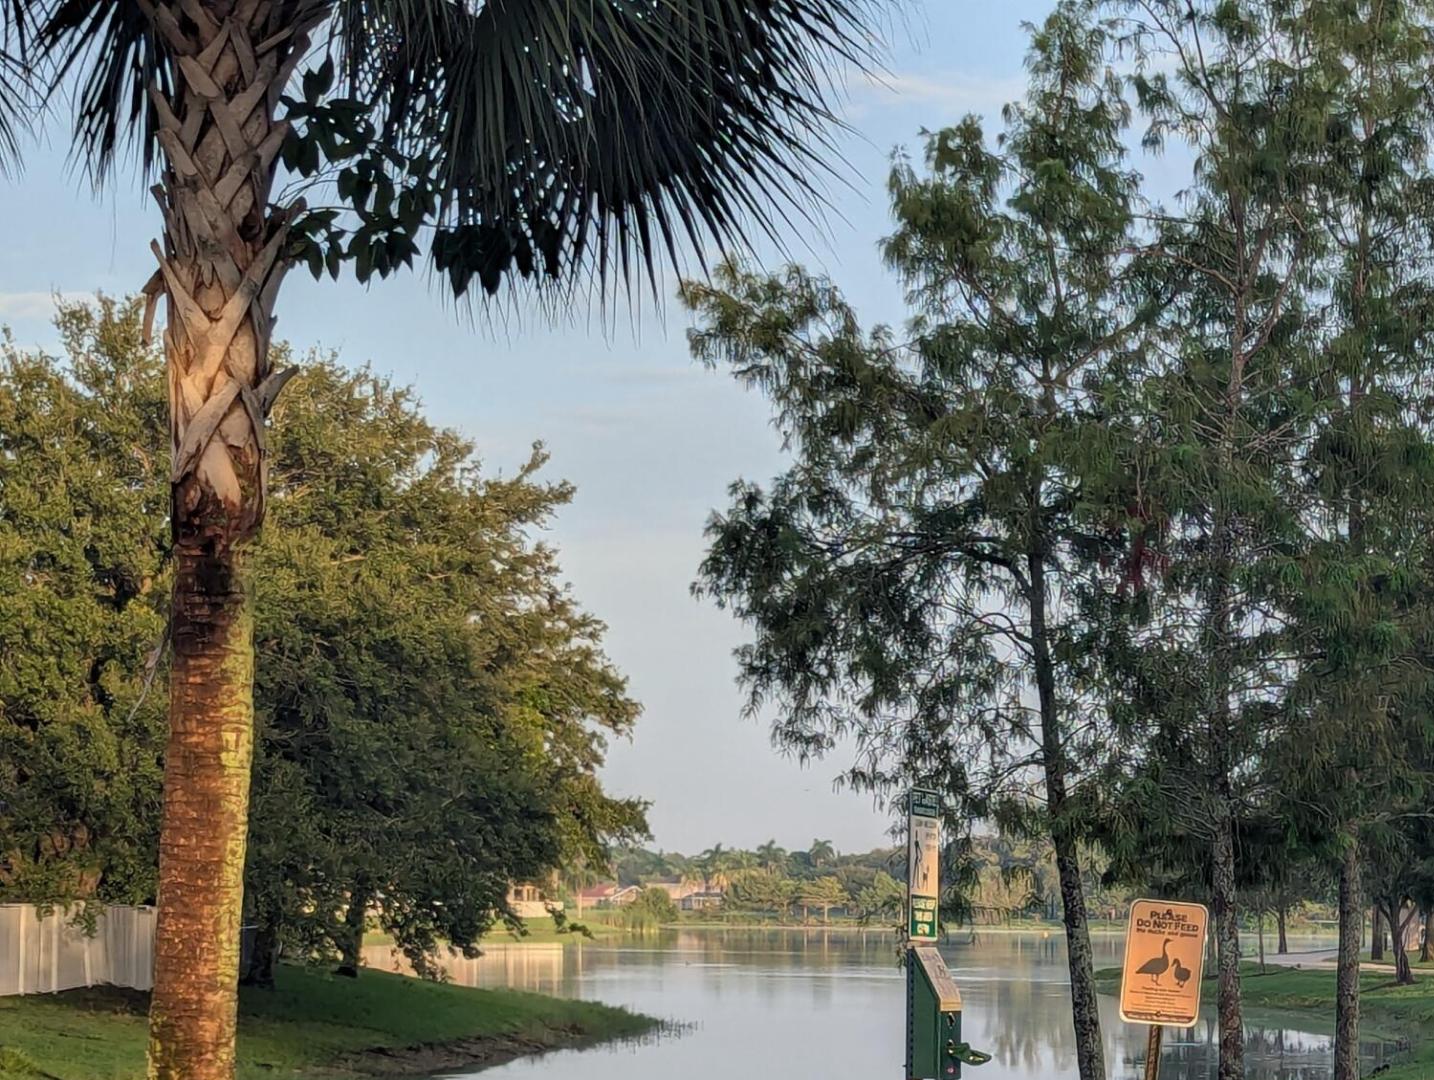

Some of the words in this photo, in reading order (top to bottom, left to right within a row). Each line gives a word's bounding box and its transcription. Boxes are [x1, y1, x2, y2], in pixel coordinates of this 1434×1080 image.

[1137, 919, 1151, 928] DO
[1153, 919, 1173, 930] NOT
[1174, 922, 1199, 931] FEED
